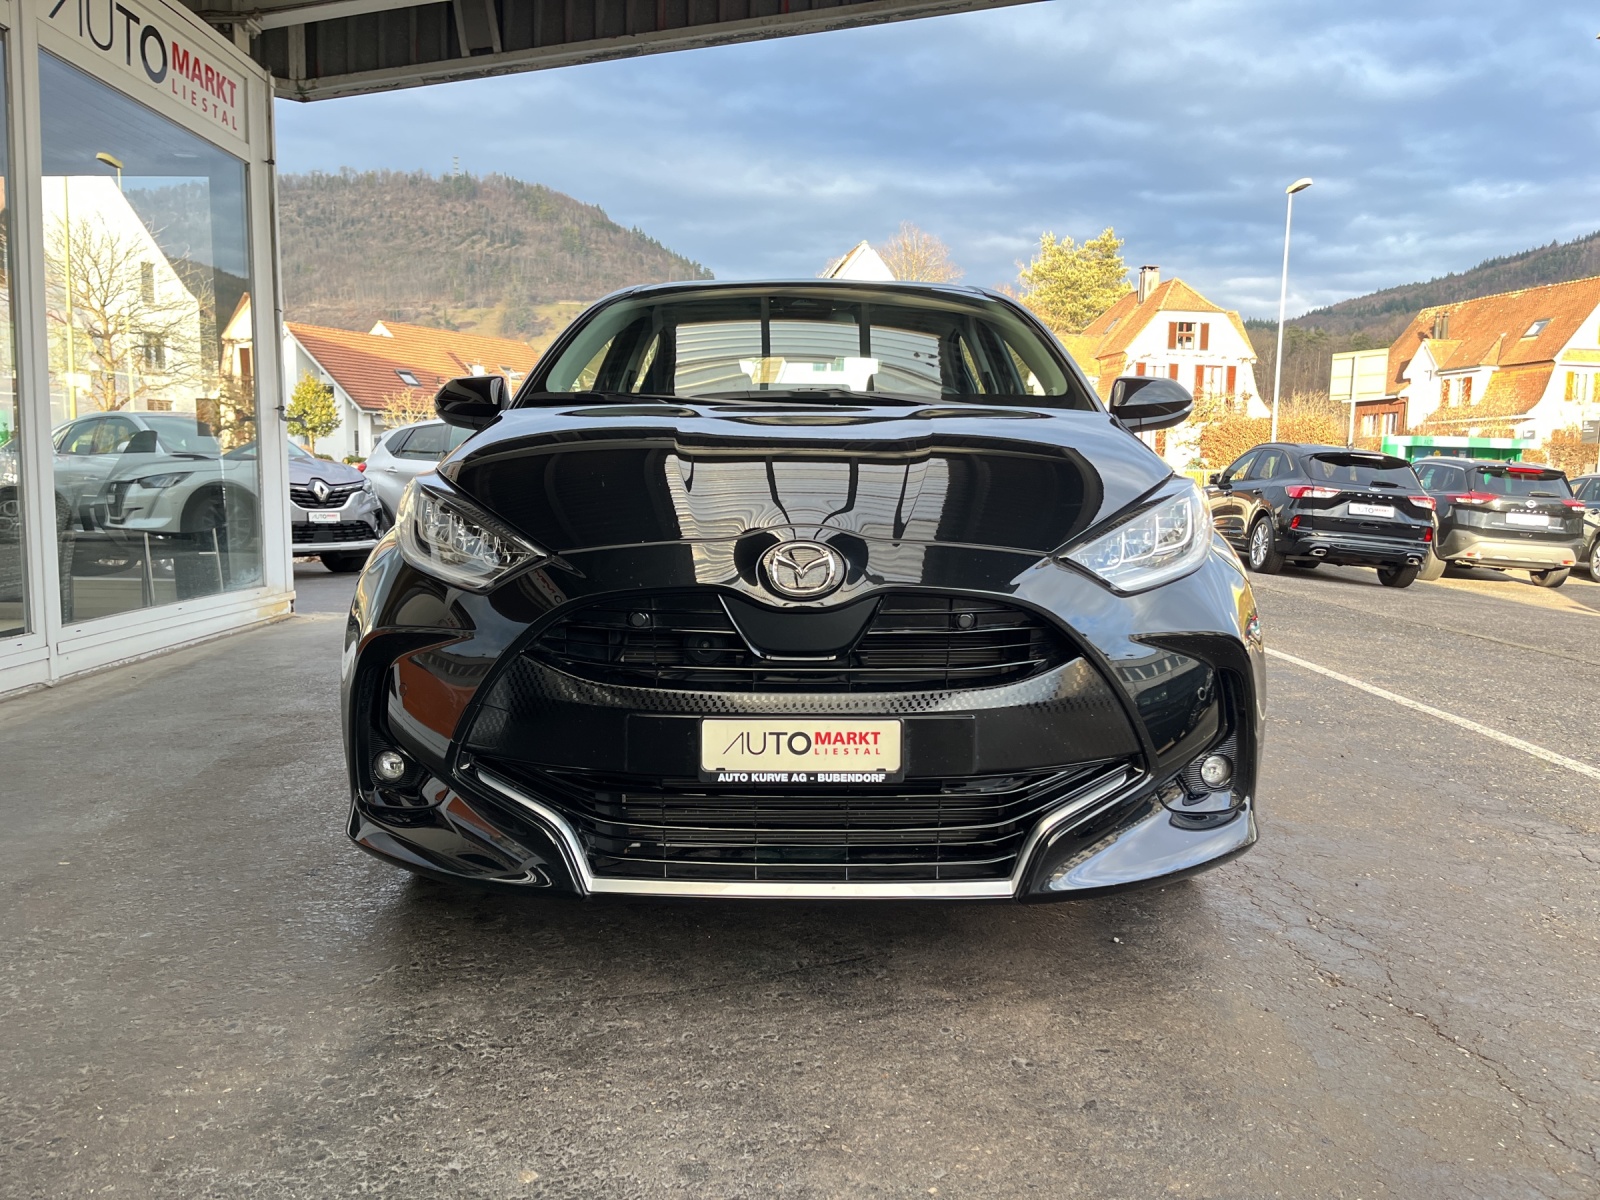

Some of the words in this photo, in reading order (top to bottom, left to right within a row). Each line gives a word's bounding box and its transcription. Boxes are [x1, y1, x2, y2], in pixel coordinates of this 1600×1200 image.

[171, 77, 238, 132] LIESTAL
[814, 747, 881, 755] LIESTAL
[717, 773, 749, 783] AUTO
[751, 773, 789, 783] KURVE
[791, 773, 807, 783] AG
[817, 773, 886, 783] BUBENDORF
